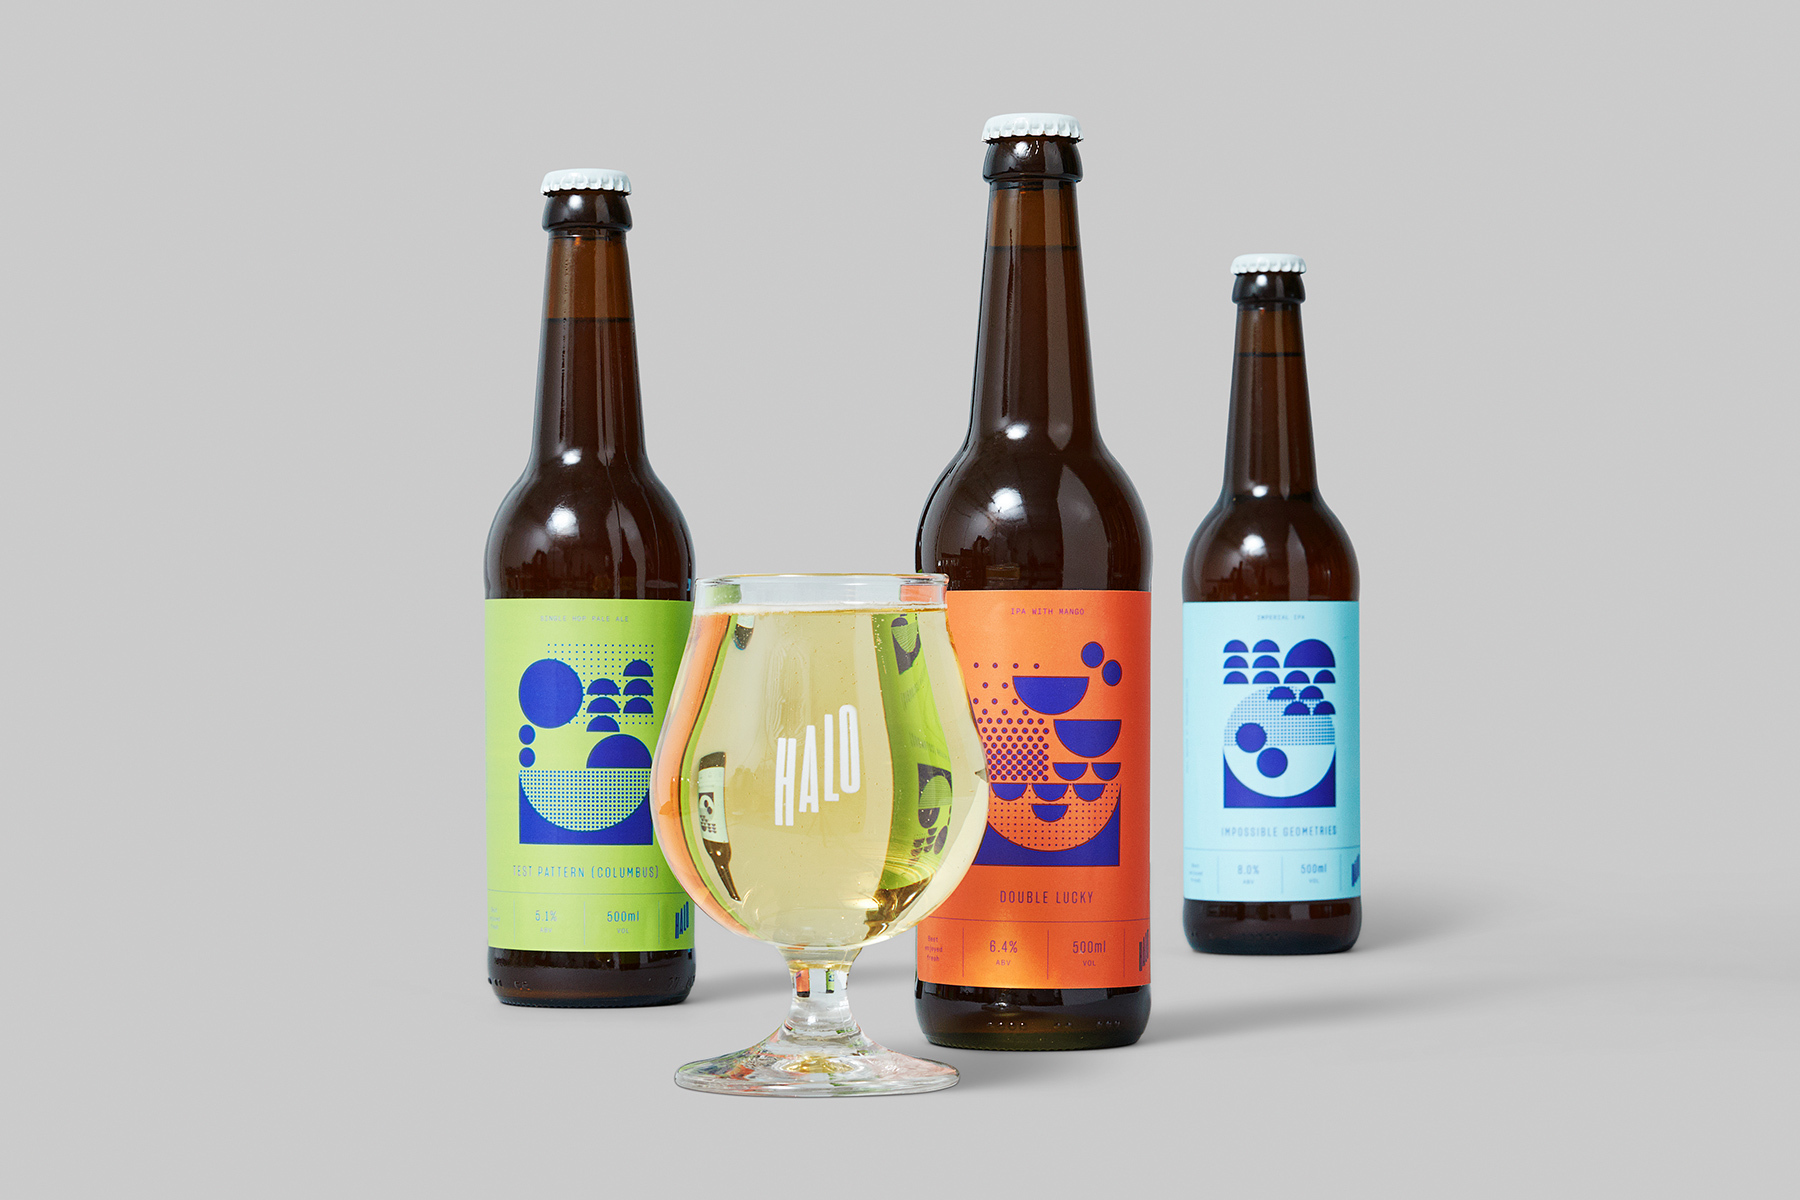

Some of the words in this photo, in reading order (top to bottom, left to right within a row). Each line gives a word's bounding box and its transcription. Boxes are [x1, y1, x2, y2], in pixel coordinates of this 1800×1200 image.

[1010, 607, 1027, 616] IPA
[1031, 607, 1054, 616] WITH
[1058, 607, 1085, 616] MANGO
[539, 615, 567, 623] SINGLE
[591, 615, 610, 623] PALE
[615, 615, 629, 623] ALE
[774, 704, 861, 827] HALO
[1220, 826, 1278, 838] IMPOSSIBLE
[1282, 824, 1338, 837] GEOMETRIES
[512, 864, 533, 877] TEST
[537, 865, 585, 878] PATTERN
[591, 865, 659, 879] (COLUMBUS)
[1236, 864, 1260, 875] 8.0%
[1300, 863, 1328, 874] 500ml
[999, 890, 1049, 904] DOUBLE
[1055, 890, 1094, 904] LUCKY
[534, 909, 558, 922] 5.1%
[606, 910, 640, 923] 500ml
[674, 900, 690, 939] HALO
[988, 939, 1019, 954] 6.4%
[1071, 940, 1107, 954] 500ml
[995, 959, 1012, 967] ABV
[1082, 959, 1097, 967] VOL
